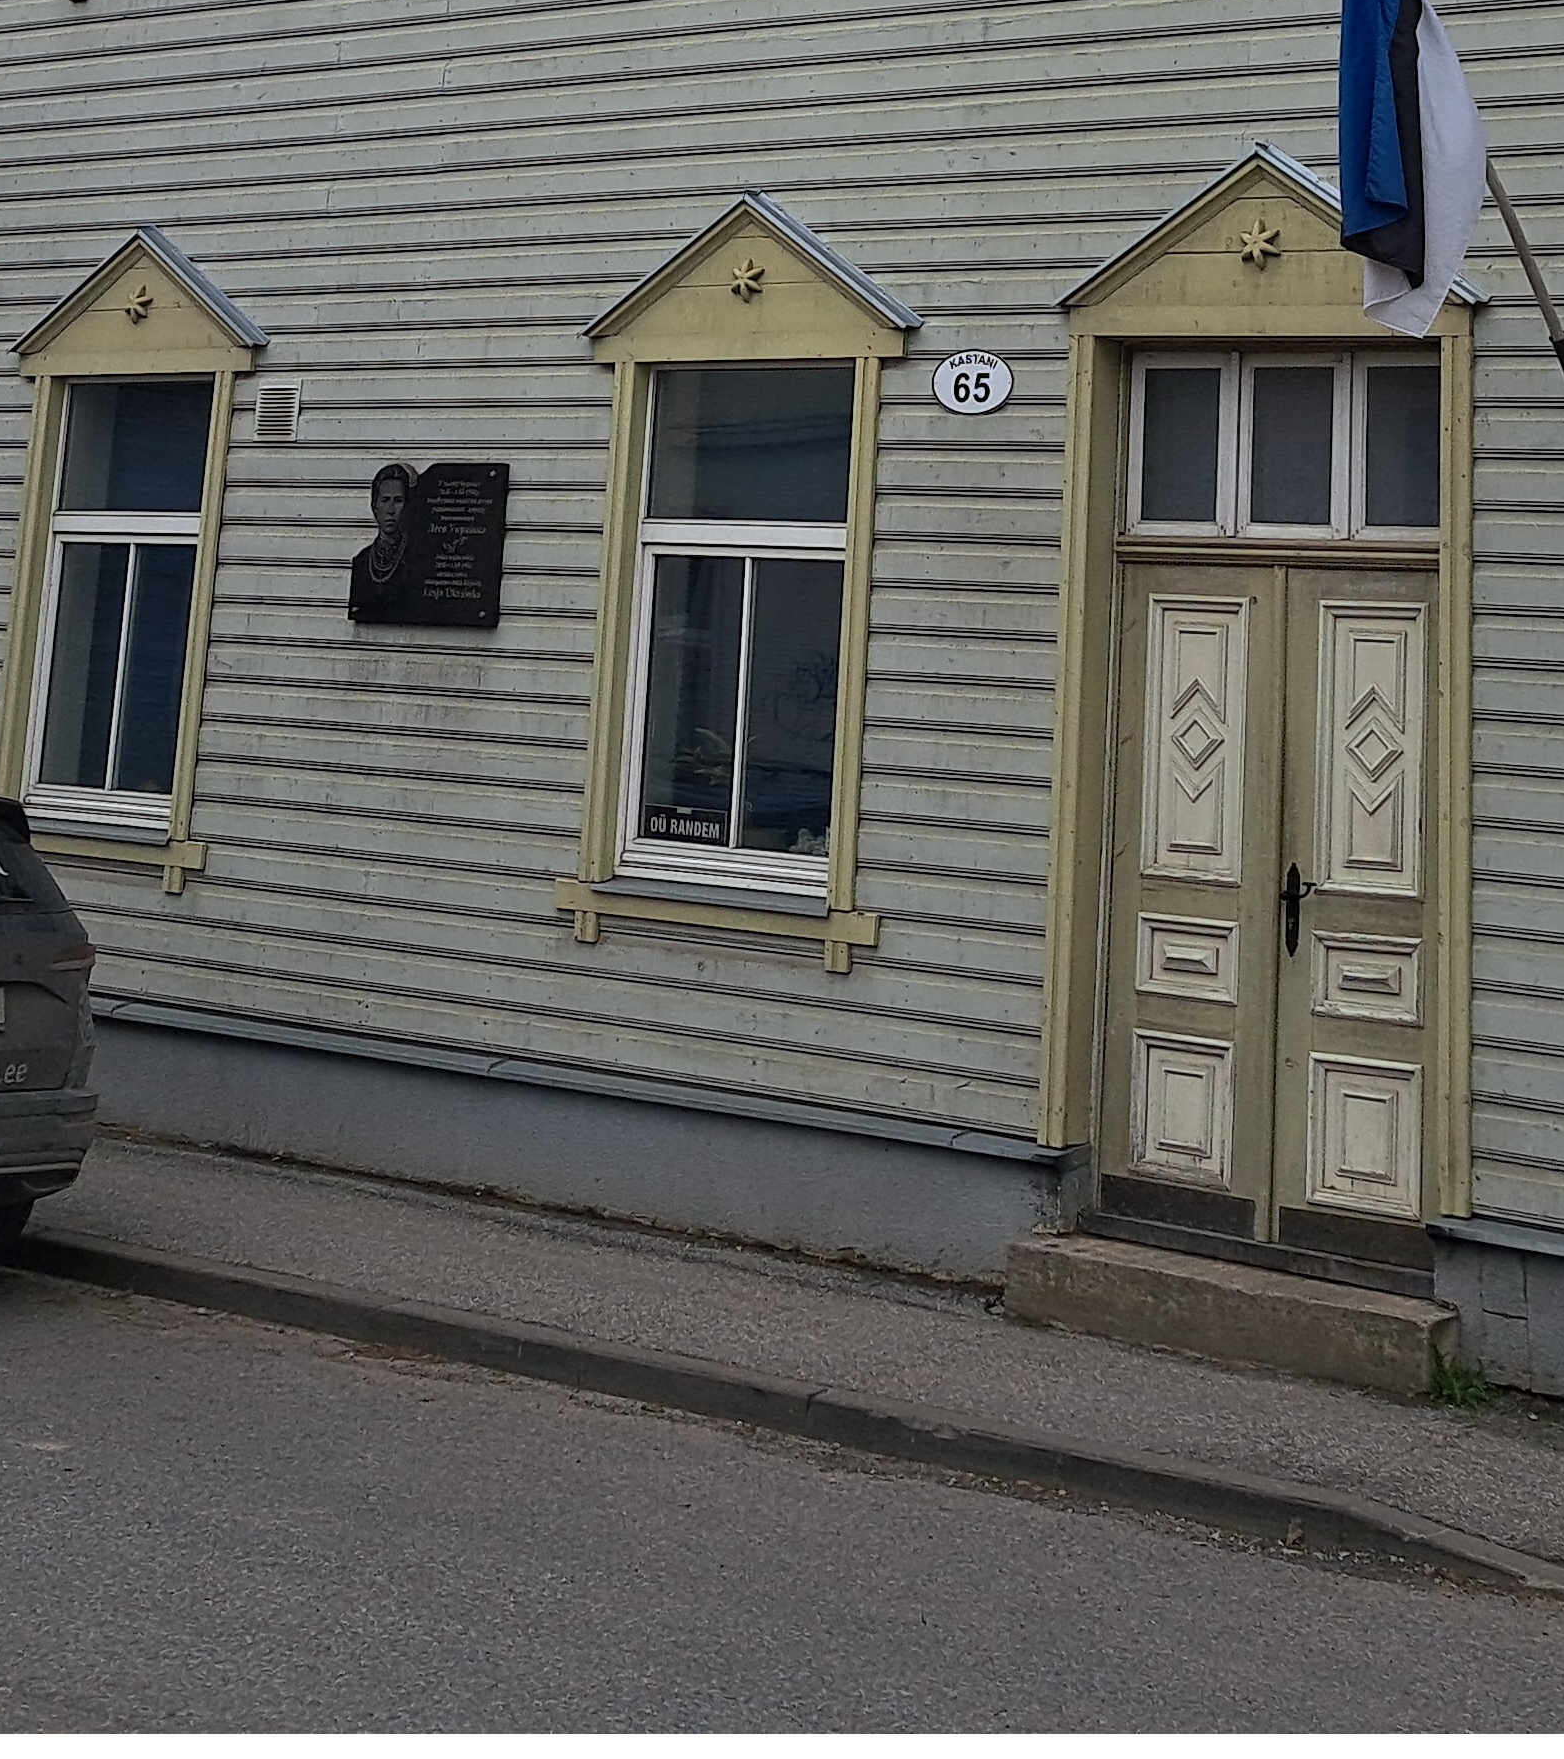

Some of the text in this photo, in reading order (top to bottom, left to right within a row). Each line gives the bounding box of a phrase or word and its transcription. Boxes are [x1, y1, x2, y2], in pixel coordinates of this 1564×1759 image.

[949, 354, 998, 369] KASTANI
[954, 373, 990, 403] 65
[650, 813, 720, 839] OÜ RANDEM
